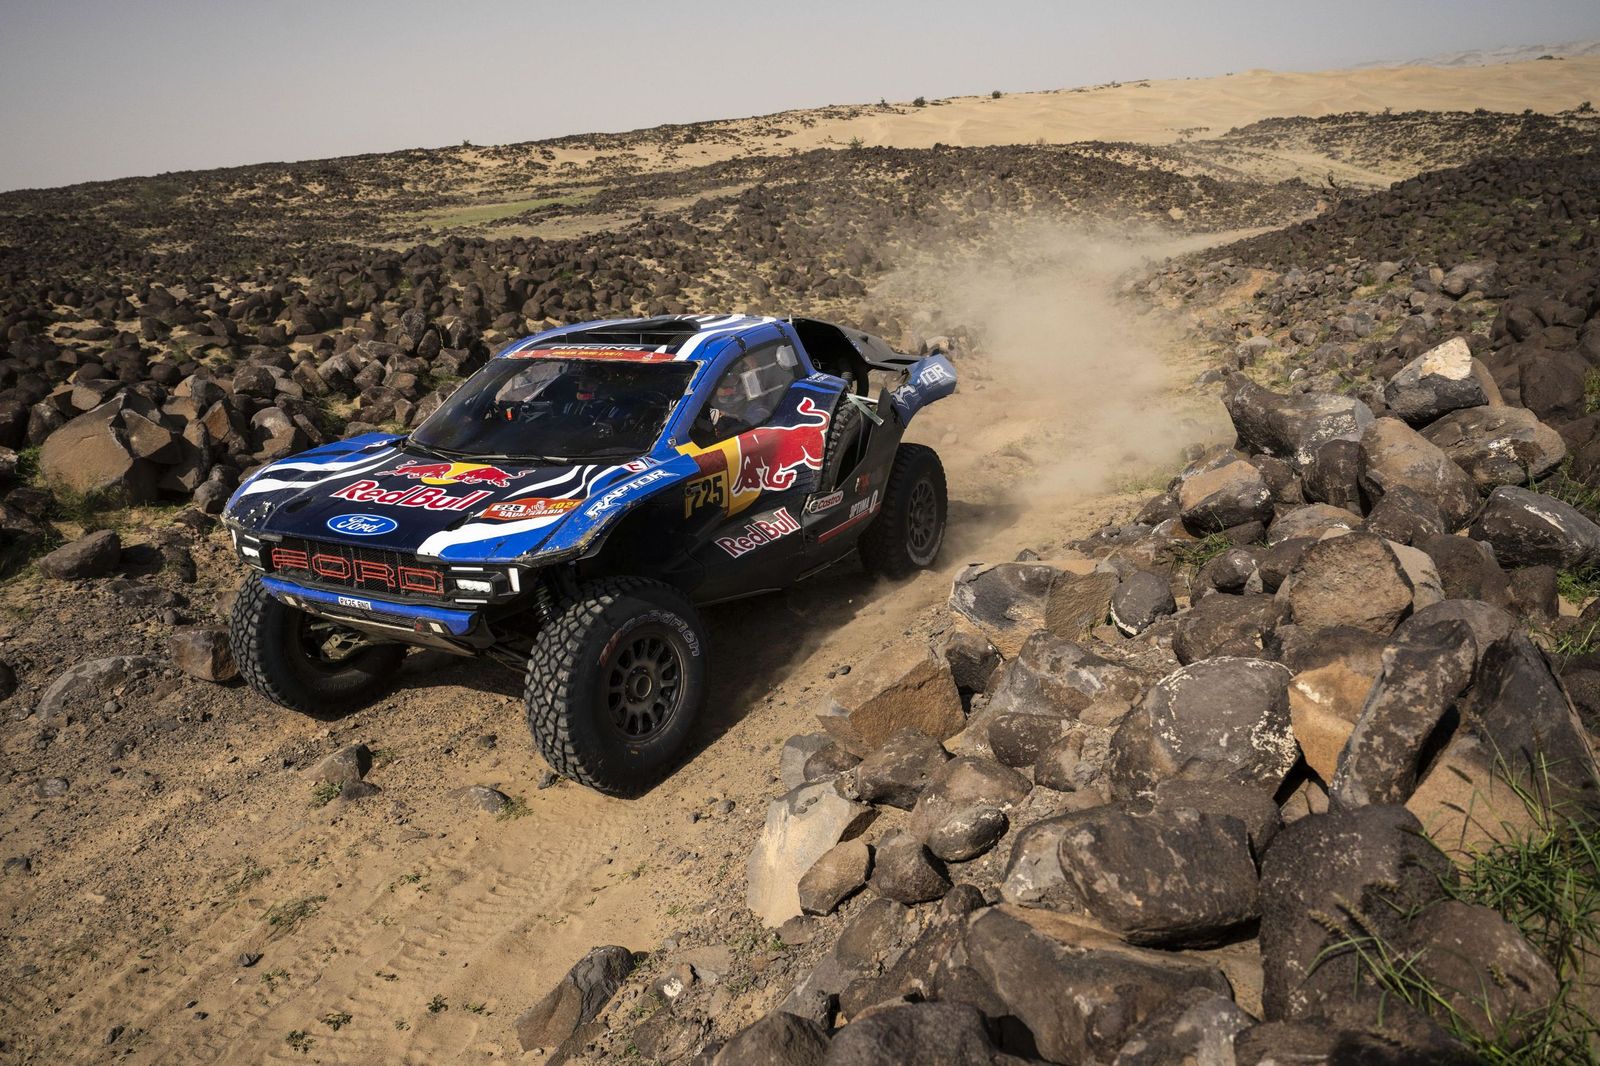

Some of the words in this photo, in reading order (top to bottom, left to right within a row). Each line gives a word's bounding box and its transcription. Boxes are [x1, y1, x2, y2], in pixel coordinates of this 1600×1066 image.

[584, 469, 680, 519] RAPTOR
[337, 516, 386, 533] Ford
[272, 548, 444, 594] FORD
